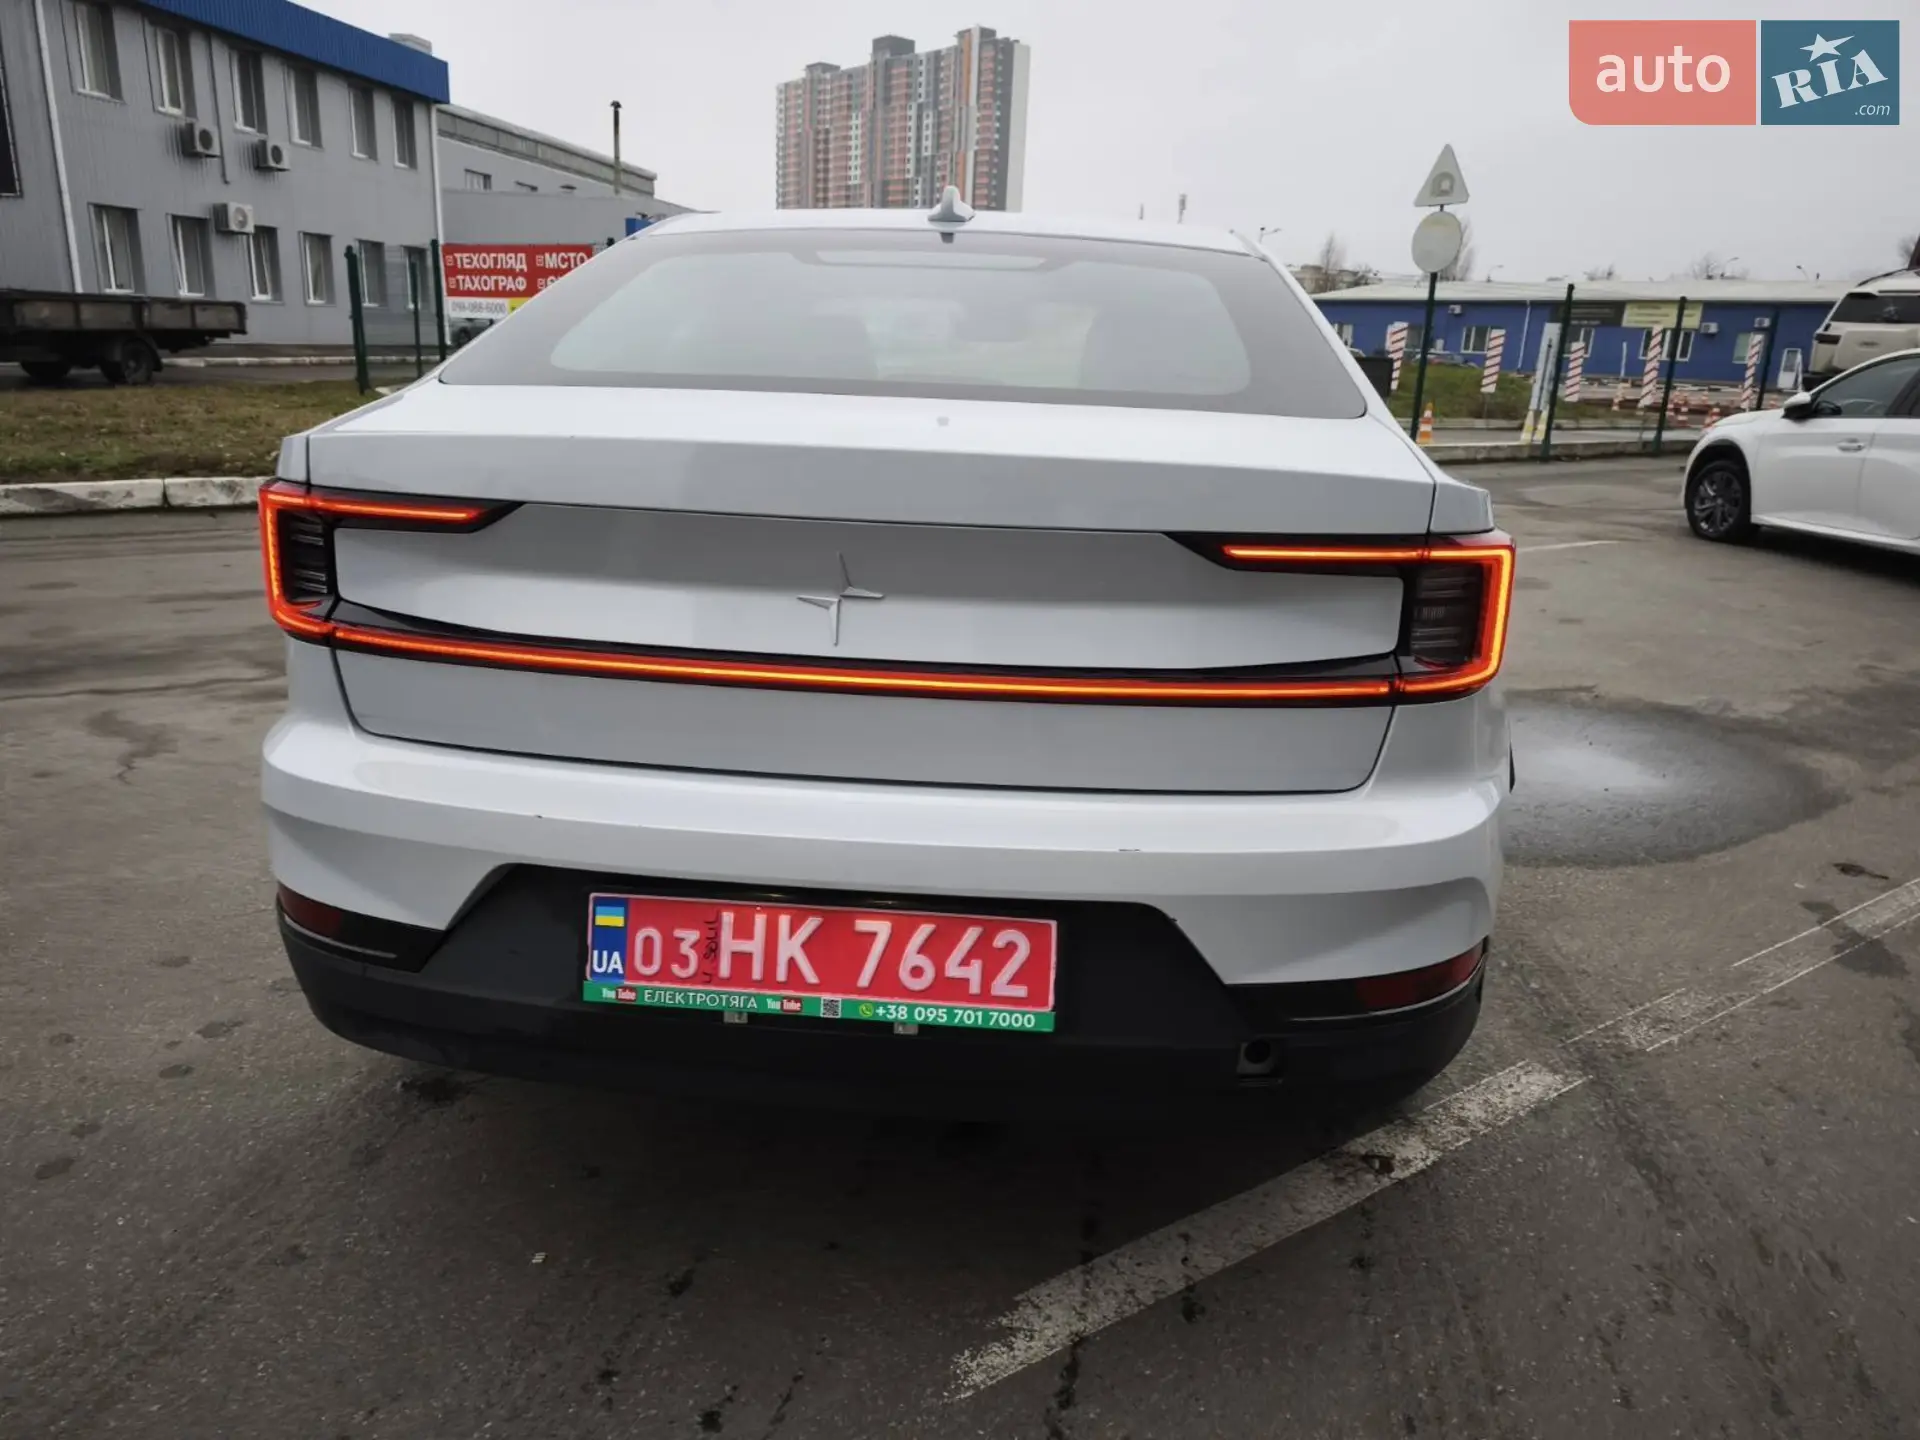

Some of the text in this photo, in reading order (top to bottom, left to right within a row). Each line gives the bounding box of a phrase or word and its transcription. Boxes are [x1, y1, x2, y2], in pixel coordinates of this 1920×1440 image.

[454, 252, 528, 272] ТЕХОГЛЯД
[456, 275, 528, 292] ТАХОГРАФ
[592, 950, 624, 974] UA
[854, 919, 1031, 997] 7642
[644, 989, 758, 1010] ЕЛЕКТРОТЯГА
[876, 1005, 1036, 1028] +38 095 701 7000
